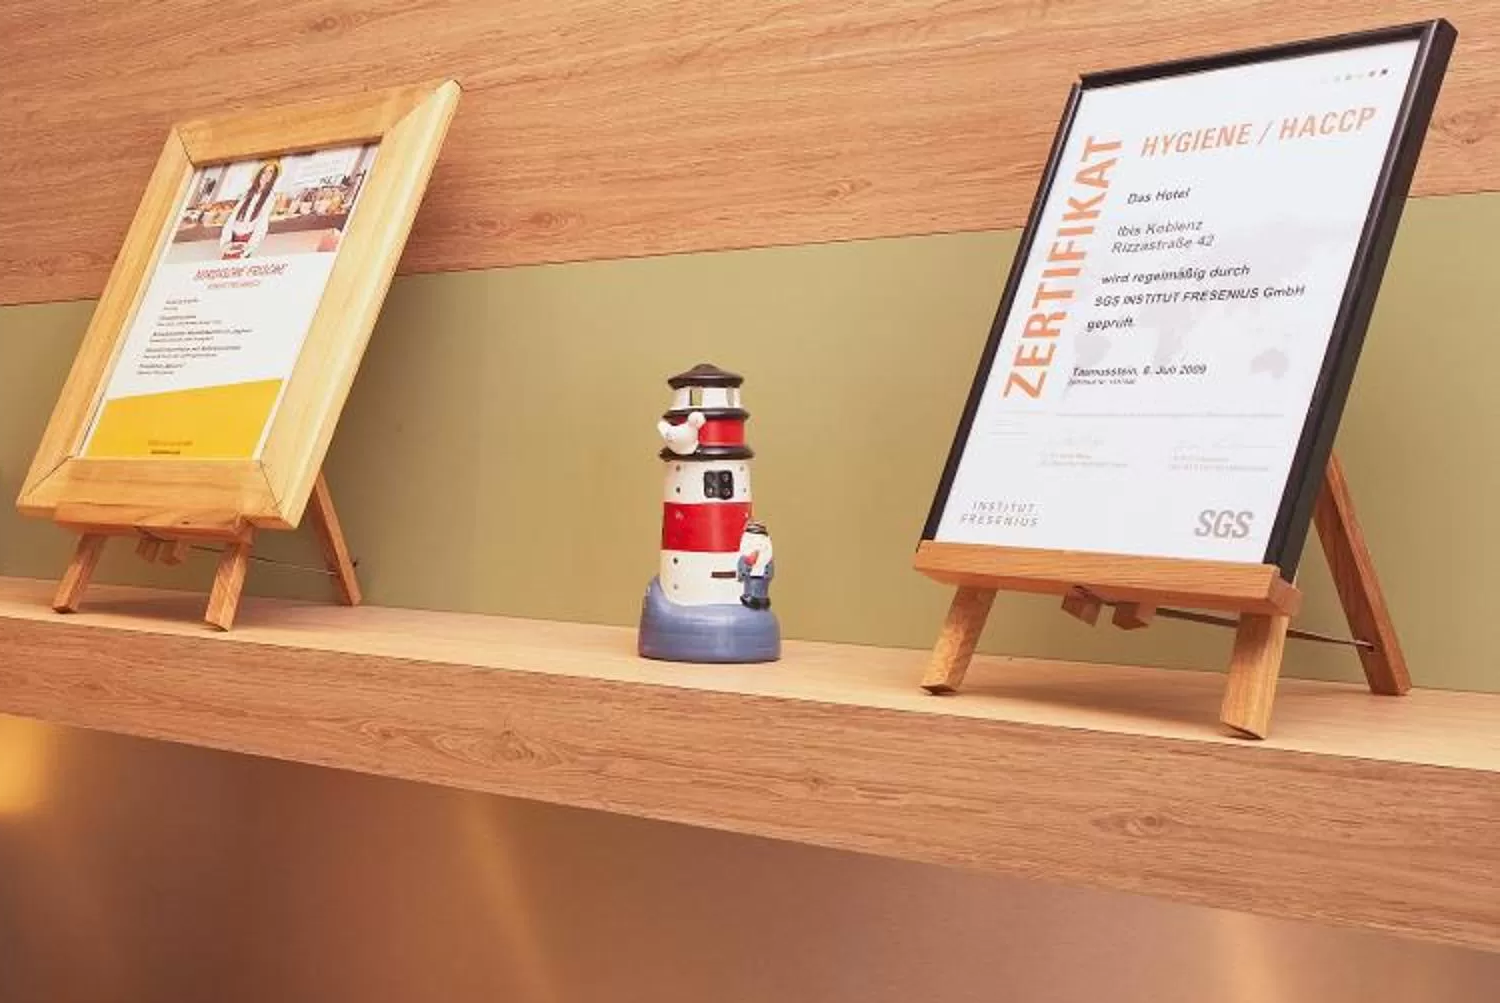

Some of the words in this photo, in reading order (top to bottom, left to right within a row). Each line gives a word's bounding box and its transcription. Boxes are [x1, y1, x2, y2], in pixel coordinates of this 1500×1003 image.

[1140, 123, 1253, 157] HYGIENE
[1257, 120, 1273, 145] /
[1279, 107, 1377, 140] HACCP
[1127, 191, 1151, 204] Das
[1155, 187, 1191, 202] Hotel
[1145, 221, 1204, 236] Koblenz
[1197, 235, 1215, 248] 42
[1003, 136, 1123, 398] ZERTIFIKAT
[1101, 271, 1130, 285] wird
[1209, 264, 1251, 279] durch
[1094, 294, 1120, 307] SGS
[1123, 291, 1180, 305] INSTITUT
[1182, 287, 1259, 303] FRESENIUS
[1263, 284, 1306, 299] GmbH
[972, 500, 1037, 514] INSTITUT
[960, 512, 1040, 528] FRESENIUS
[1194, 509, 1254, 539] SGS
